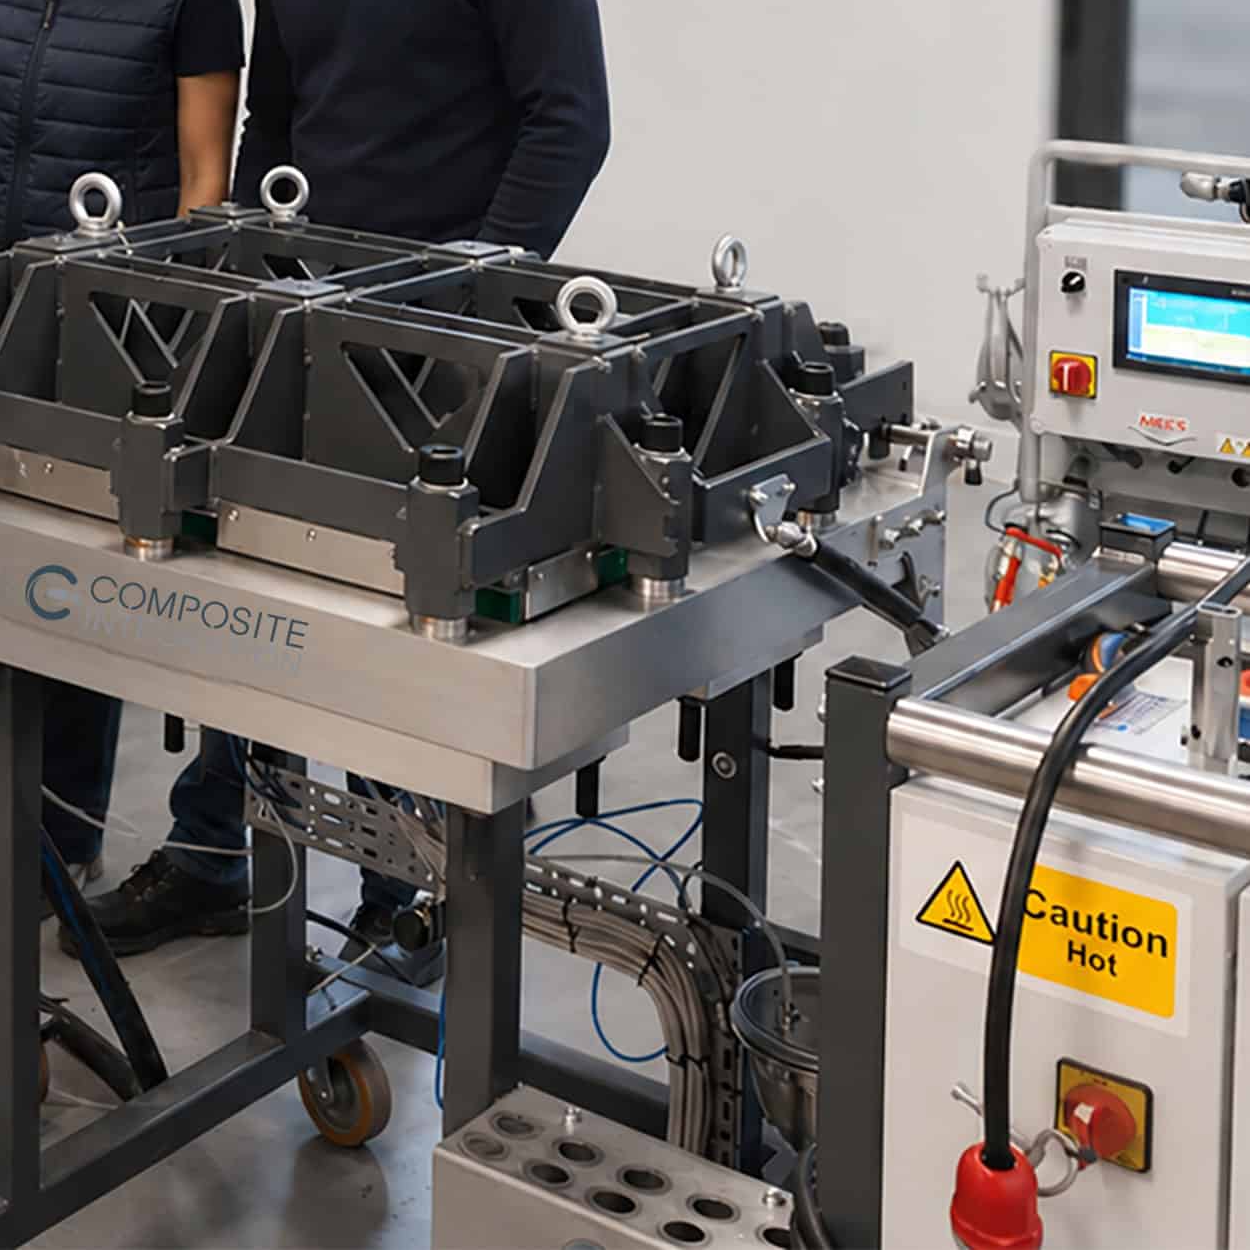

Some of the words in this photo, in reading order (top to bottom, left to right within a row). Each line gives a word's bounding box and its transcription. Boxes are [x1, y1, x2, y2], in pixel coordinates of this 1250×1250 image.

[89, 575, 310, 650] COMPOSITE
[1022, 888, 1169, 959] Caution
[1067, 940, 1118, 978] Hot
